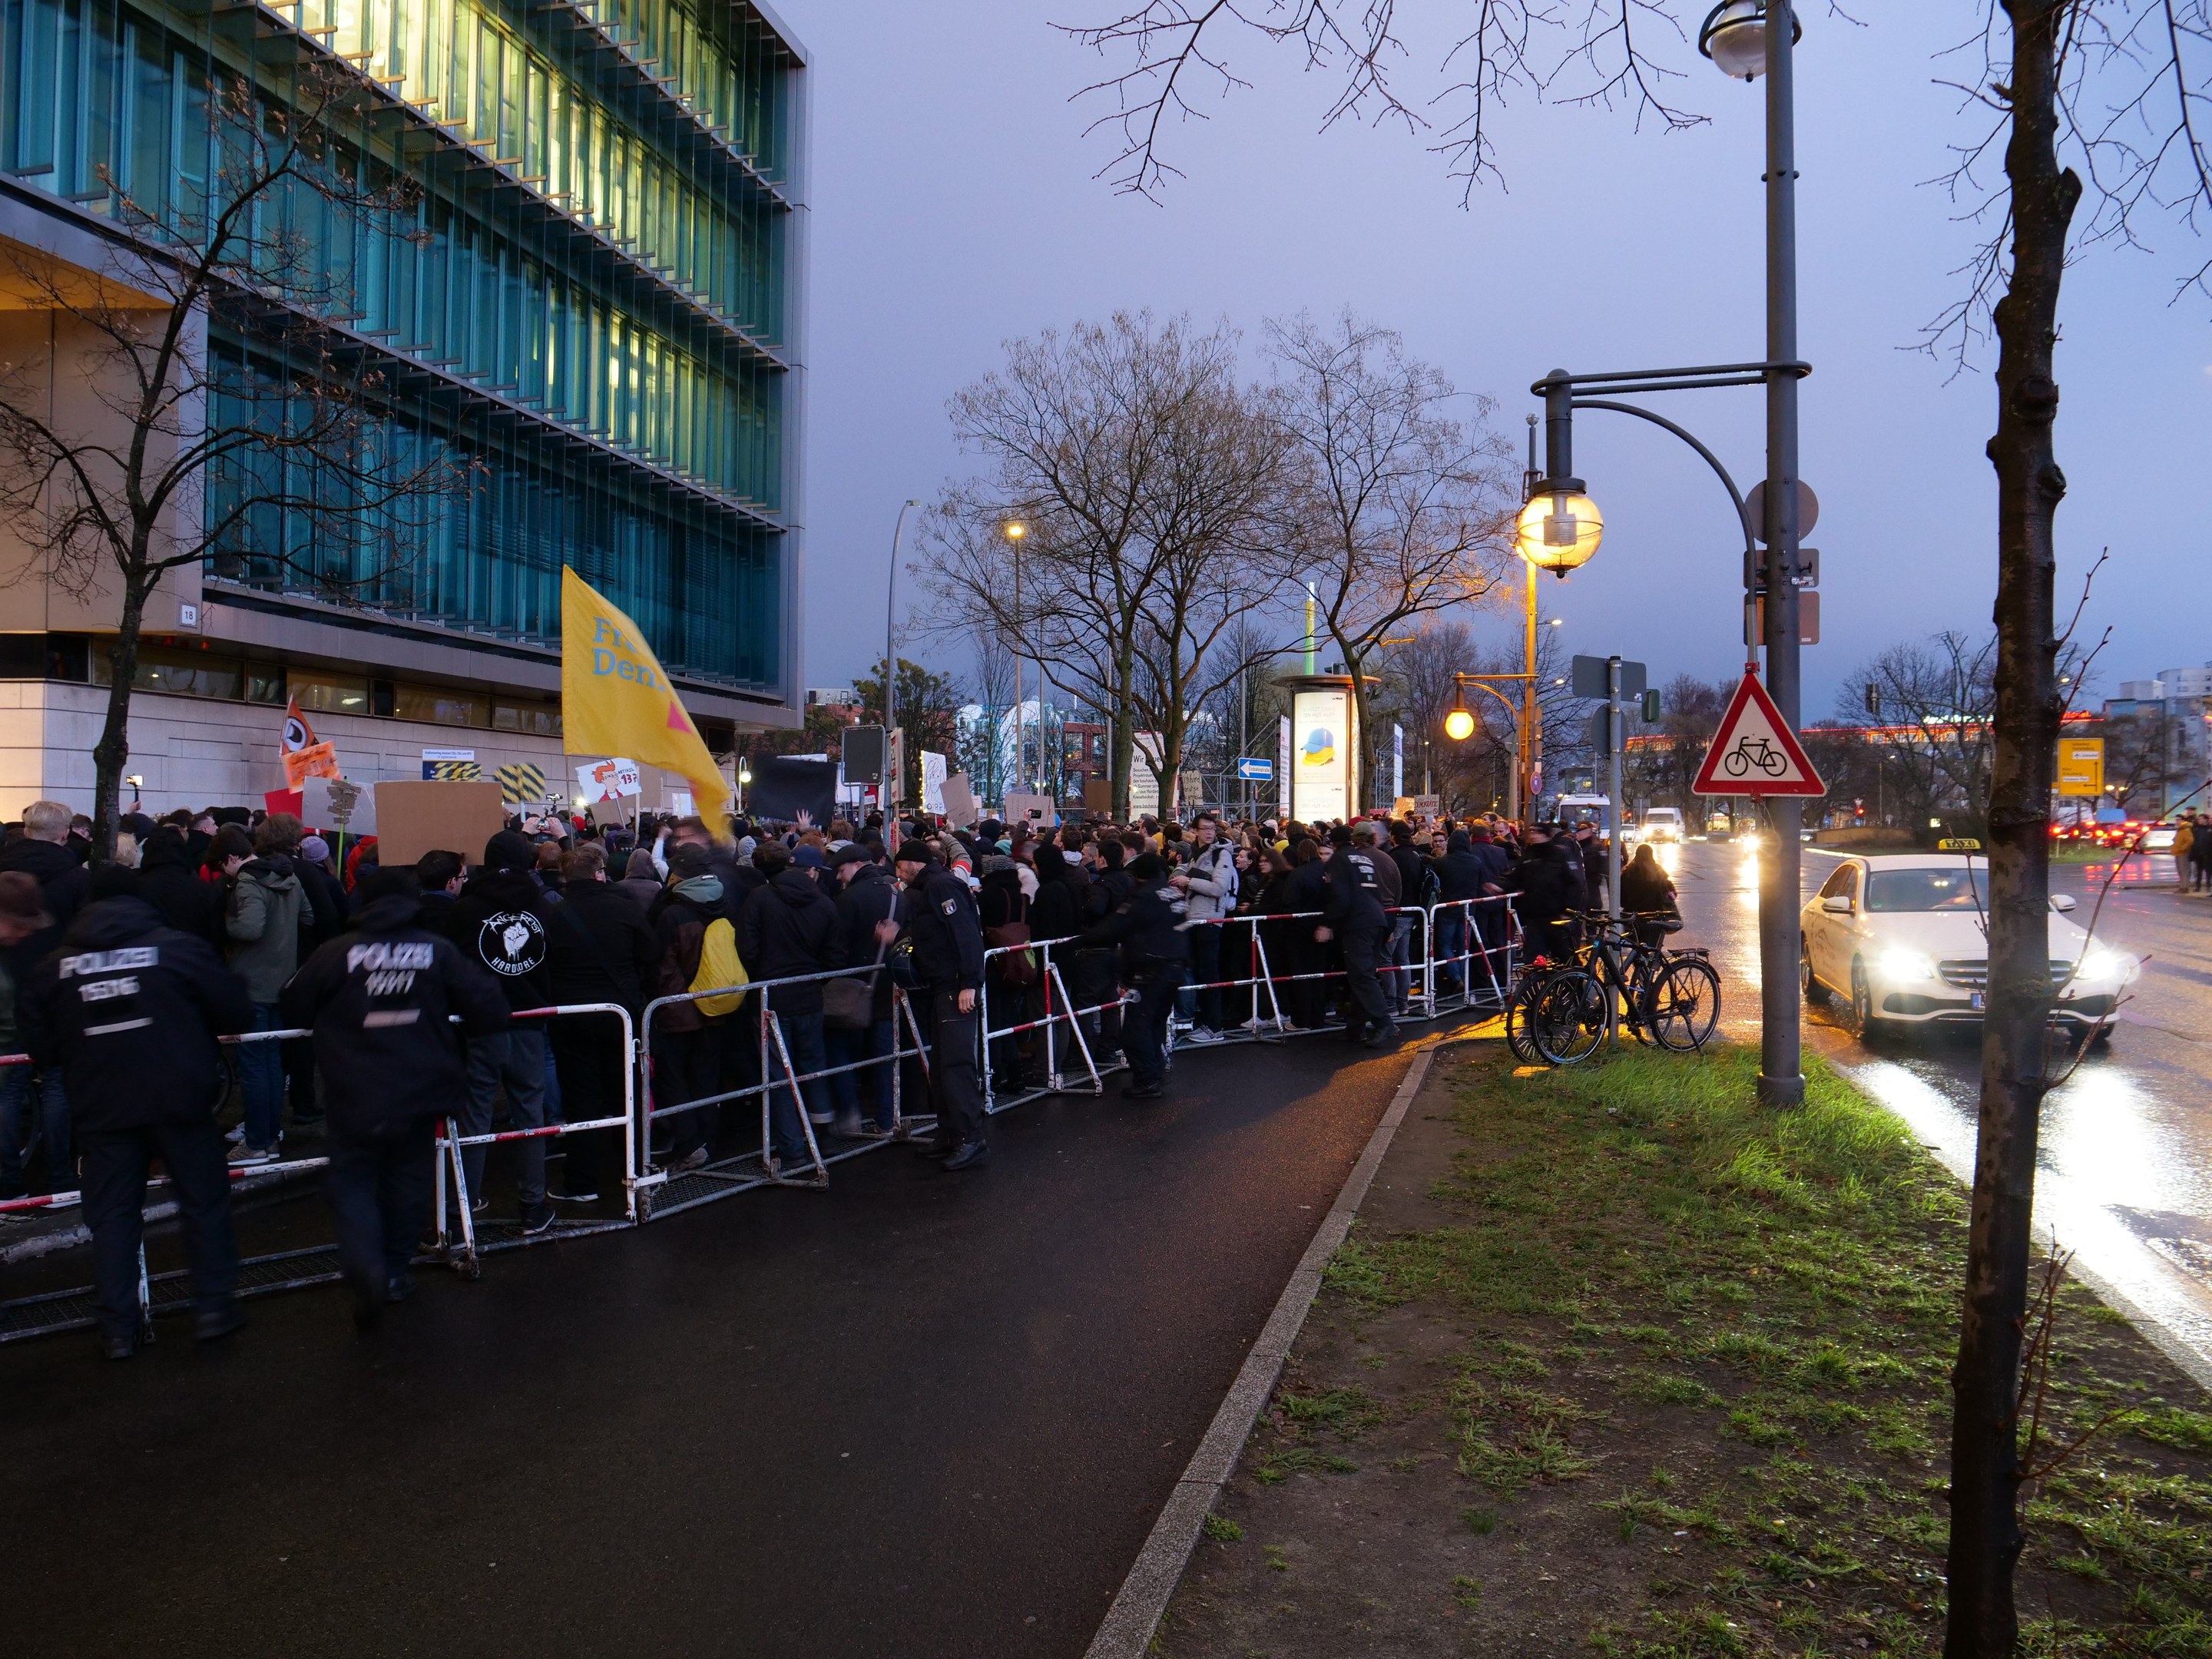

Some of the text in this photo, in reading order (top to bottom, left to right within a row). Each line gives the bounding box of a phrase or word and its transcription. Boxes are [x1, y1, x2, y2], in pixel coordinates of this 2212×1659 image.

[185, 611, 194, 620] 18
[621, 773, 637, 784] 13?
[59, 946, 159, 979] POLIZEI
[346, 942, 434, 974] POLIZEI
